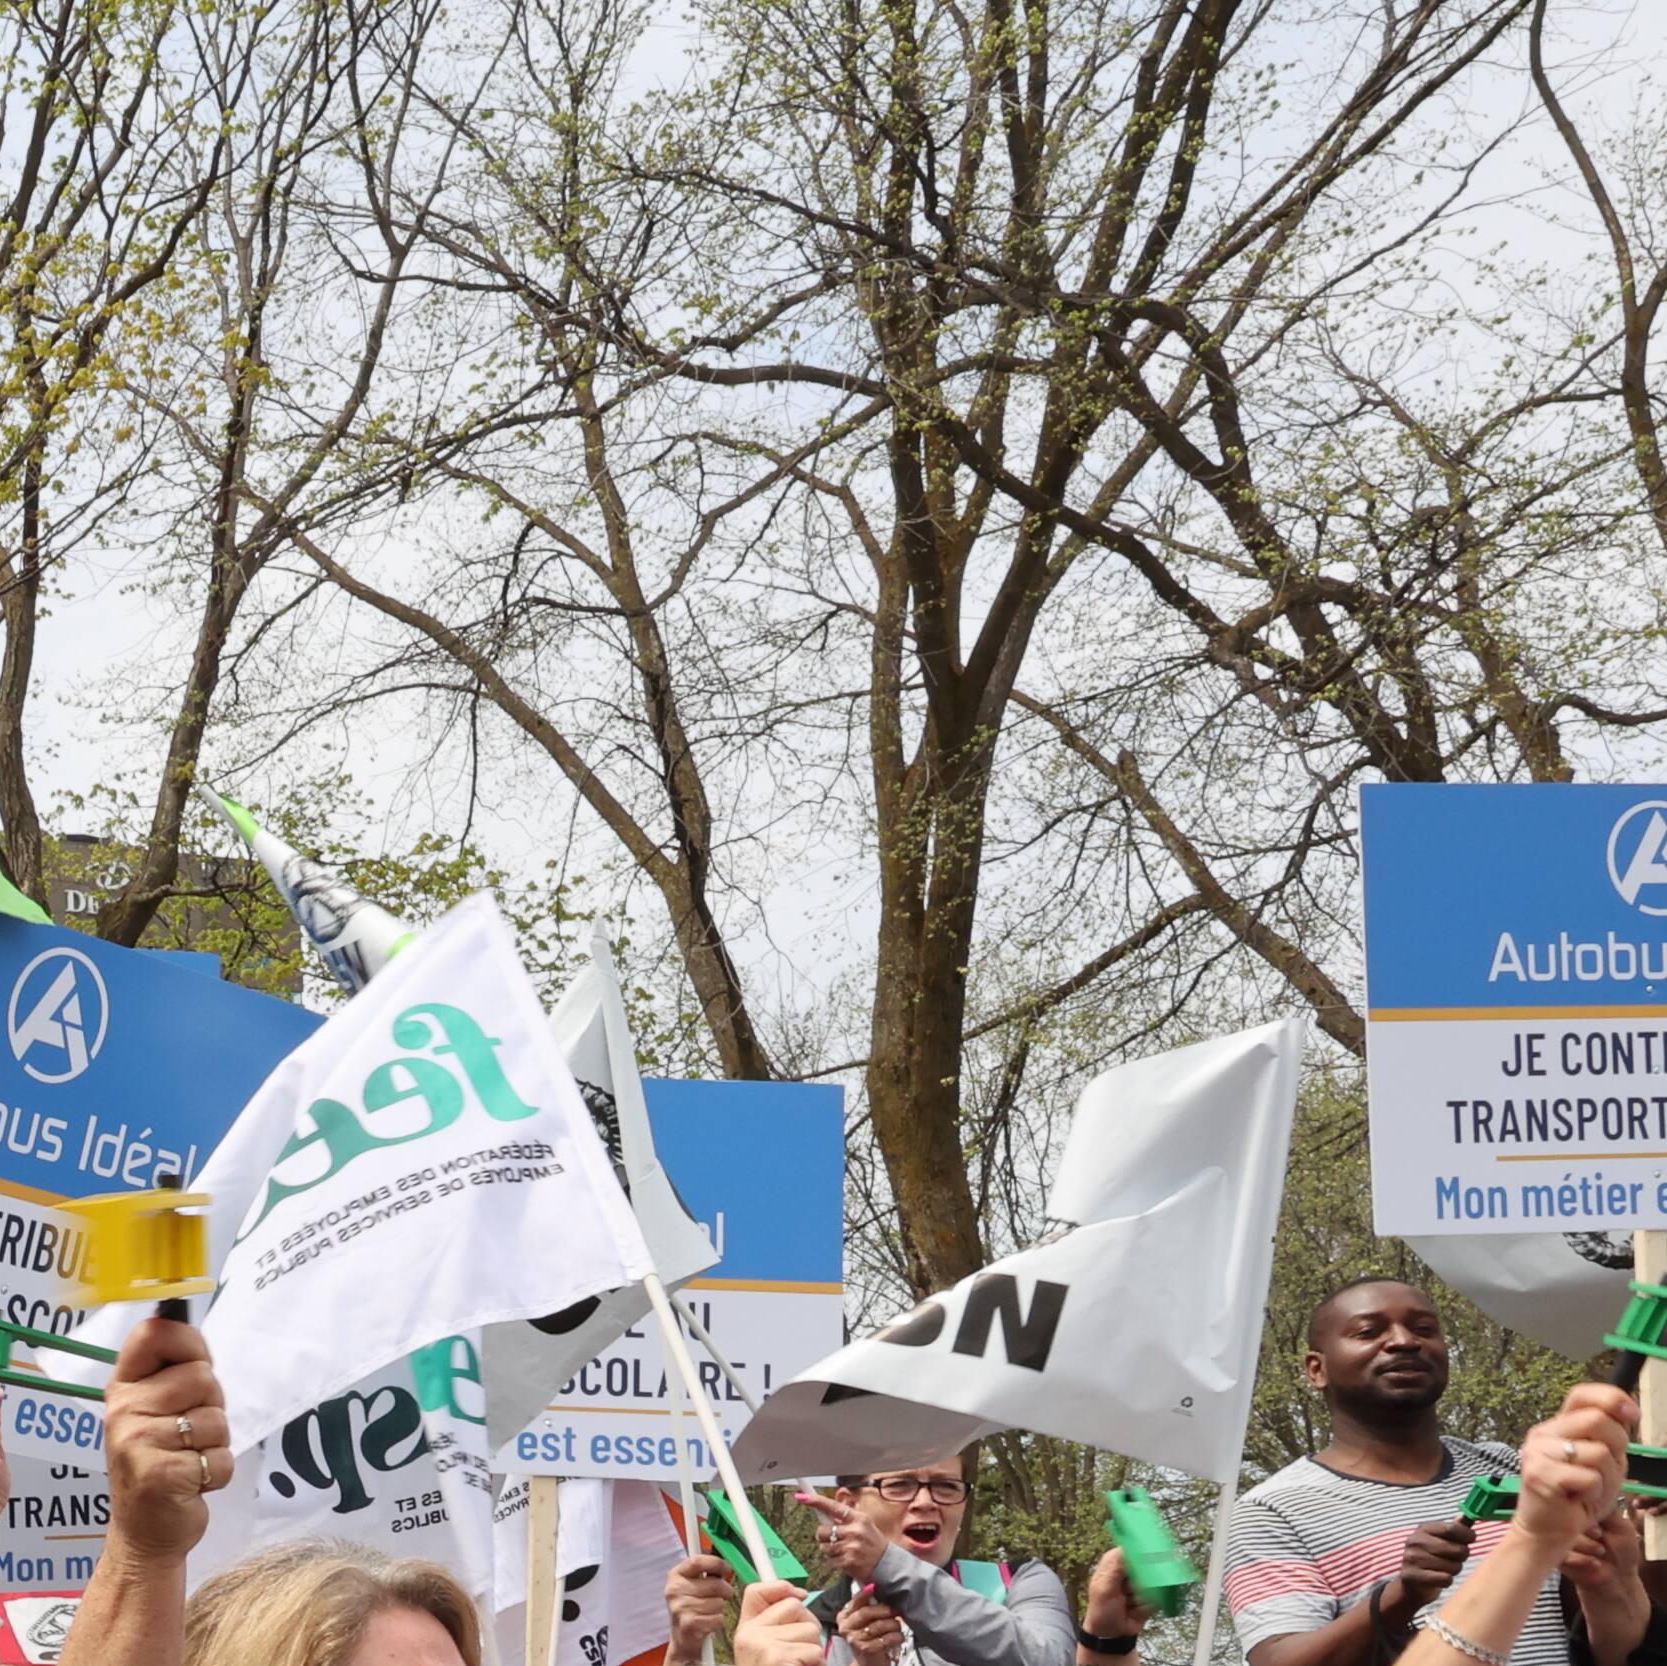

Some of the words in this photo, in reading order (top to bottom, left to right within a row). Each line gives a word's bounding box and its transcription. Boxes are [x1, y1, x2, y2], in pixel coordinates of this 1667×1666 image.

[1501, 1032, 1547, 1077] JE
[1560, 1031, 1667, 1075] CONT
[1446, 1096, 1667, 1144] TRANSPORT
[78, 1112, 197, 1191] Idéal
[1435, 1176, 1508, 1220] Mon
[1521, 1172, 1644, 1218] métier
[517, 1426, 576, 1463] est
